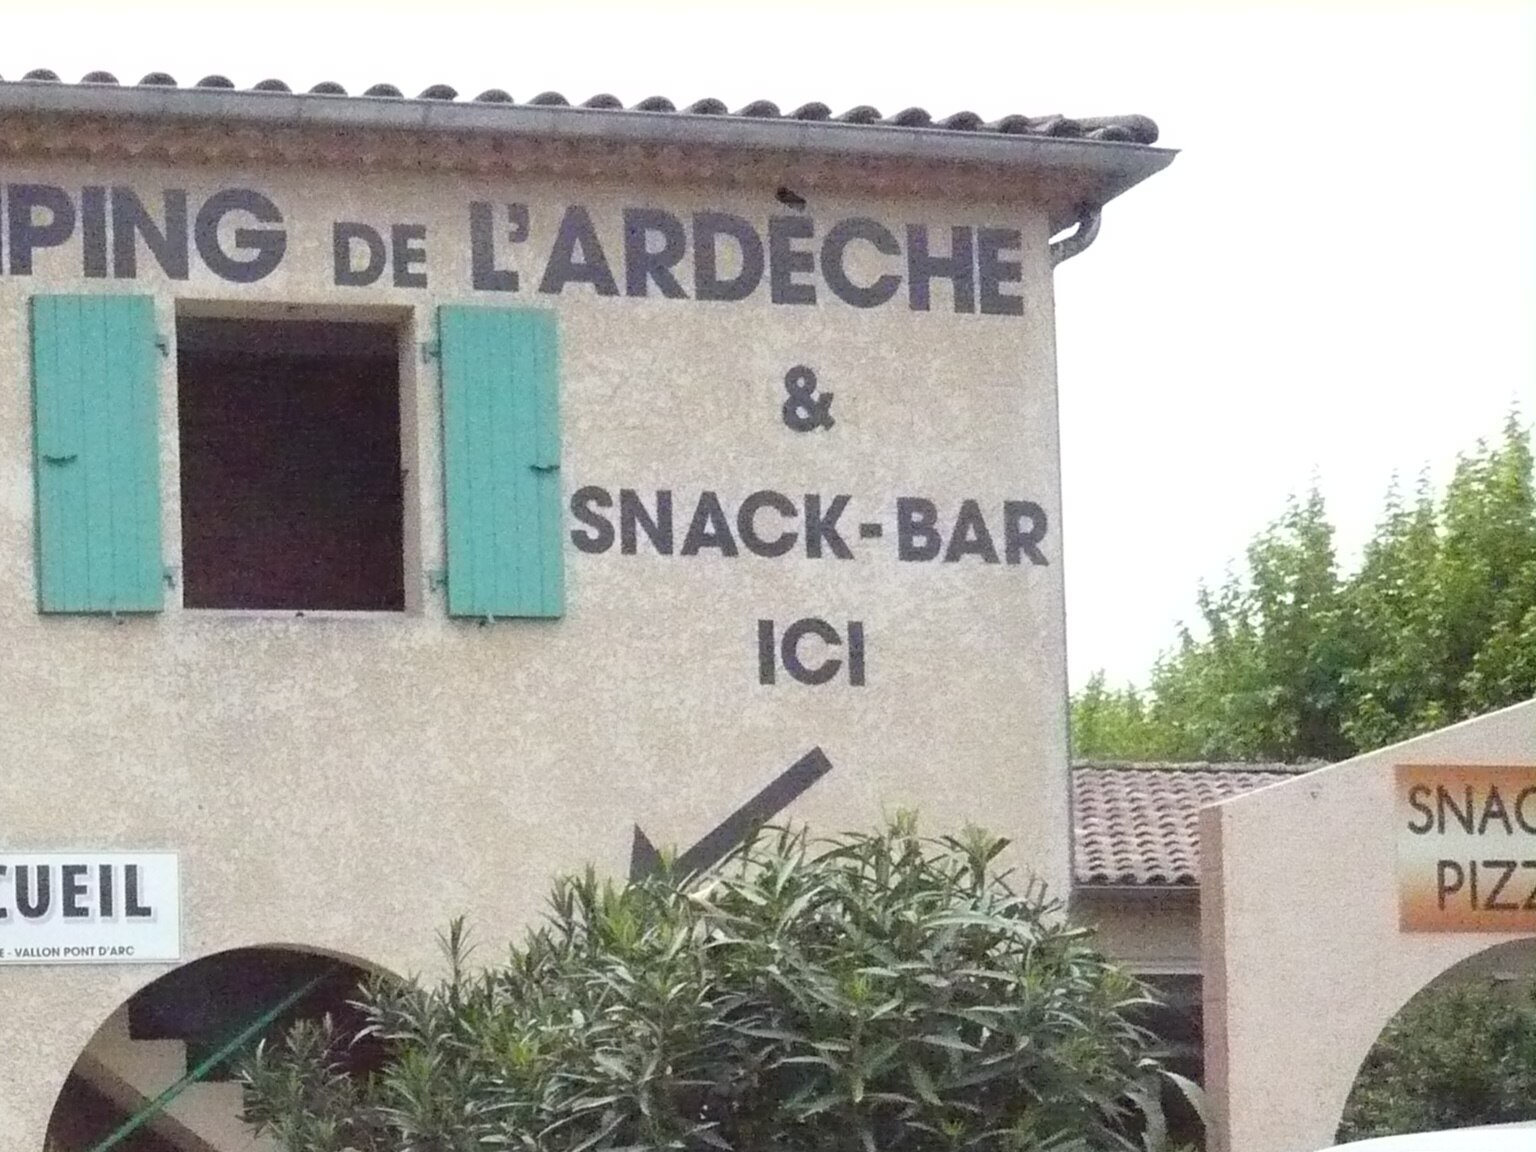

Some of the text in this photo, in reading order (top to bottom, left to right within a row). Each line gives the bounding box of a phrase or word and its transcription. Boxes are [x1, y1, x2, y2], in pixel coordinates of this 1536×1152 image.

[332, 220, 429, 290] DE
[469, 189, 1025, 316] L'ARDÈCHE
[781, 365, 837, 433] &
[569, 485, 1051, 567] SNACK-BAR
[757, 617, 866, 688] ICI
[14, 947, 61, 959] VALLON
[64, 946, 96, 958] PONT
[98, 945, 135, 957] D'ARC
